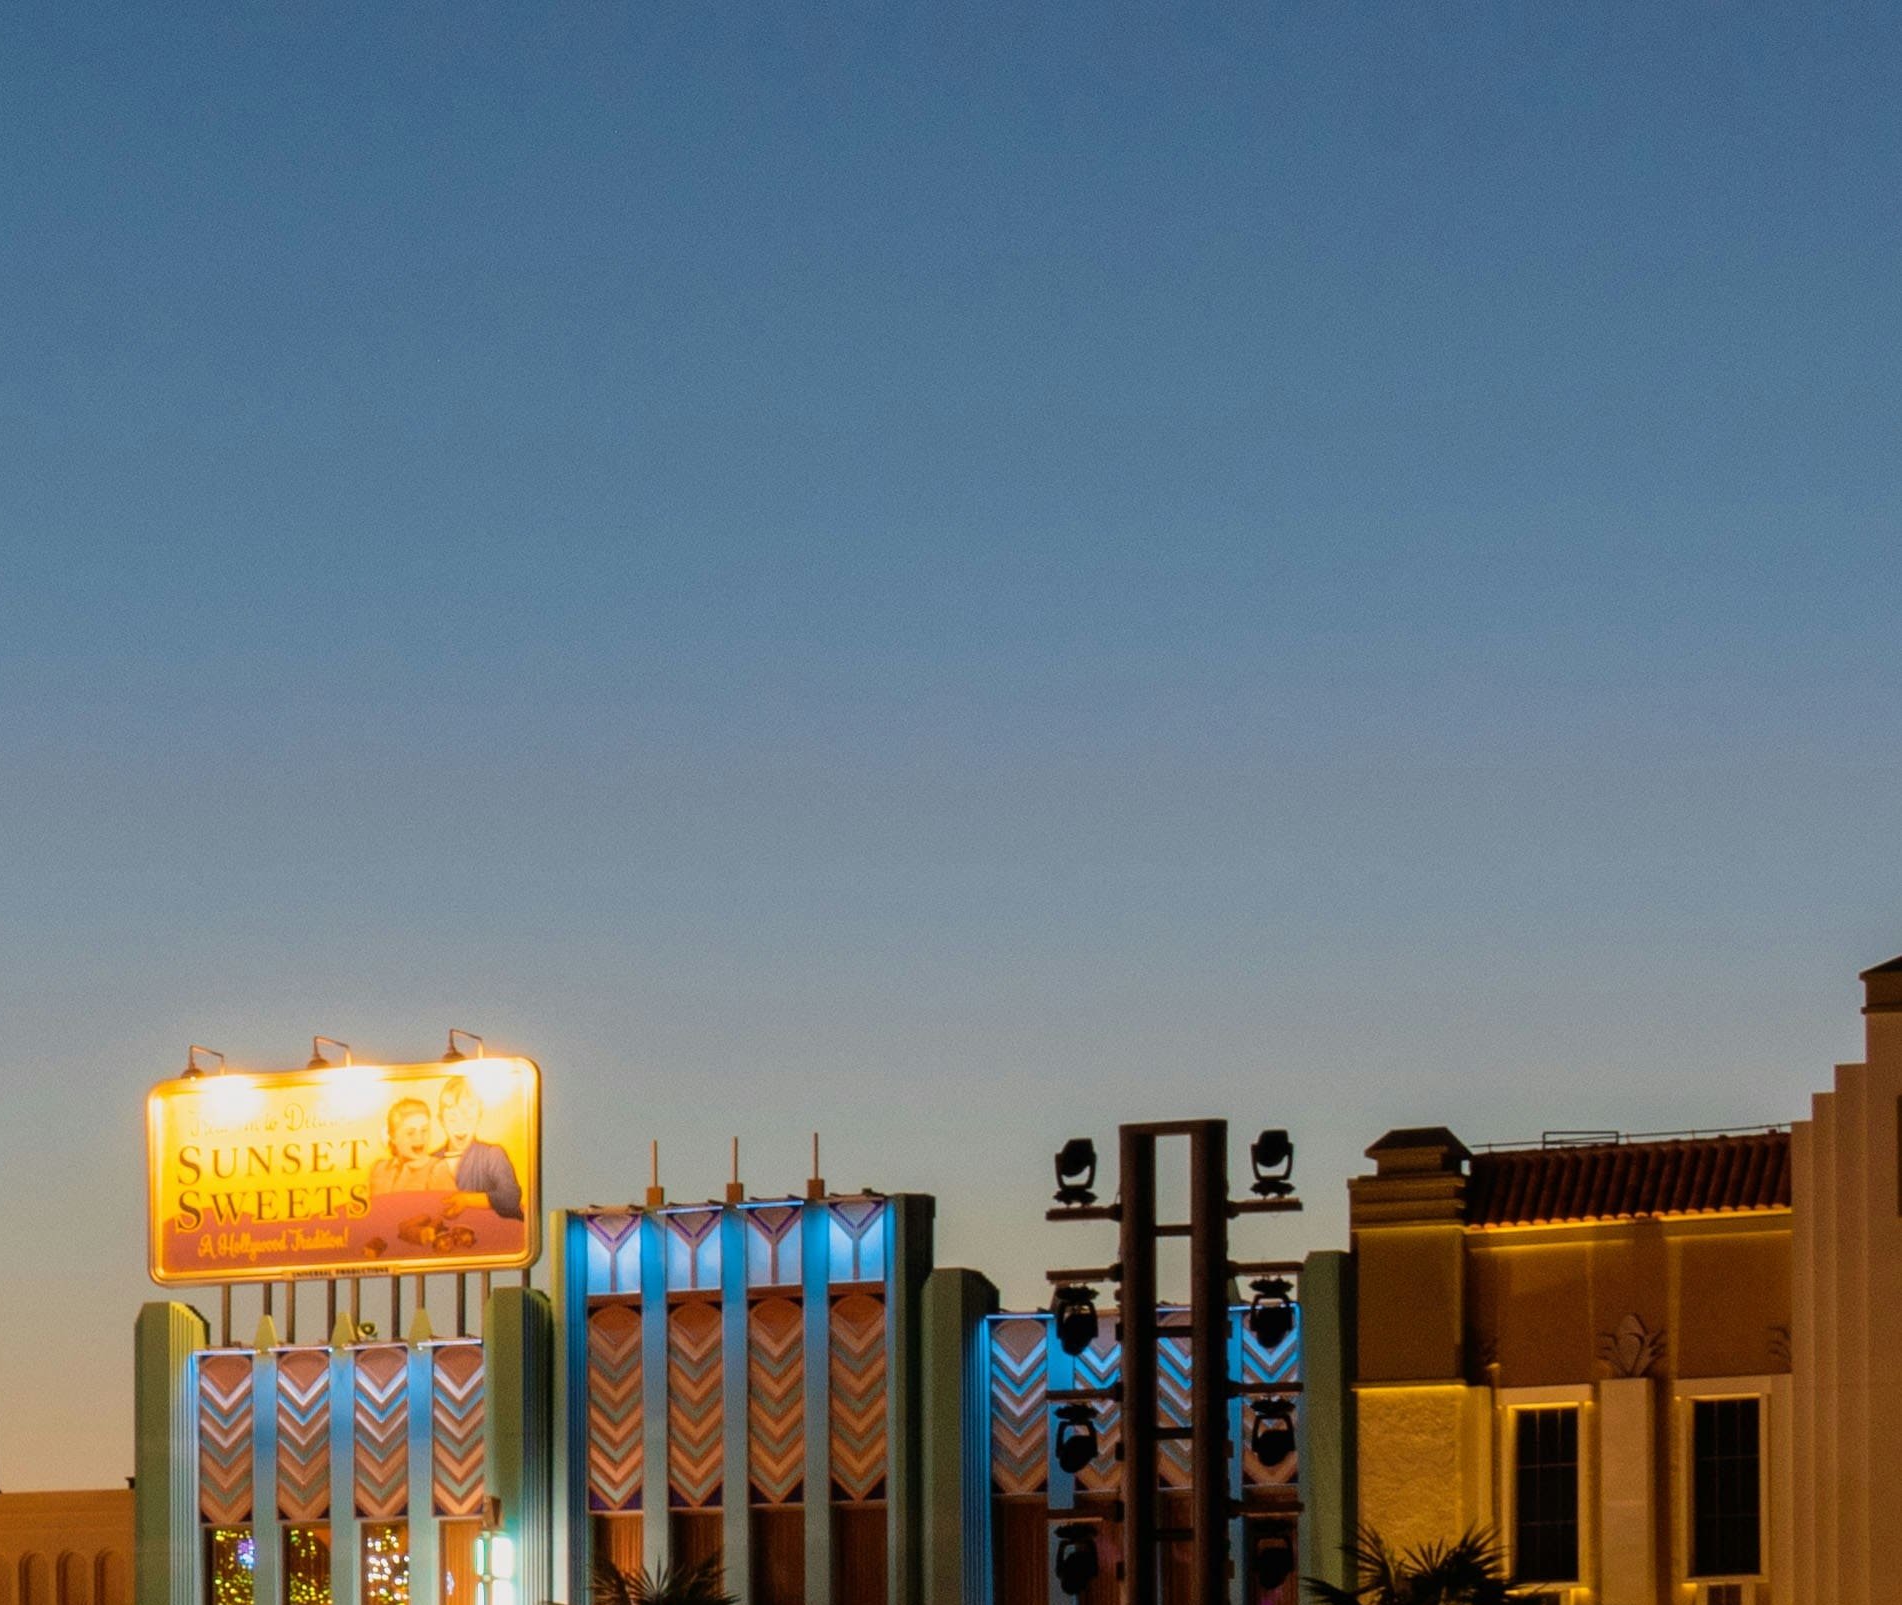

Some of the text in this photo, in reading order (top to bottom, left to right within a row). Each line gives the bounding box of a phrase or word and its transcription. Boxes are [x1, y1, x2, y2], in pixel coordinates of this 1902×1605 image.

[178, 1138, 369, 1185] SUNSET
[177, 1186, 369, 1231] SWEETS
[199, 1235, 216, 1258] A
[217, 1232, 287, 1261] Hollywood
